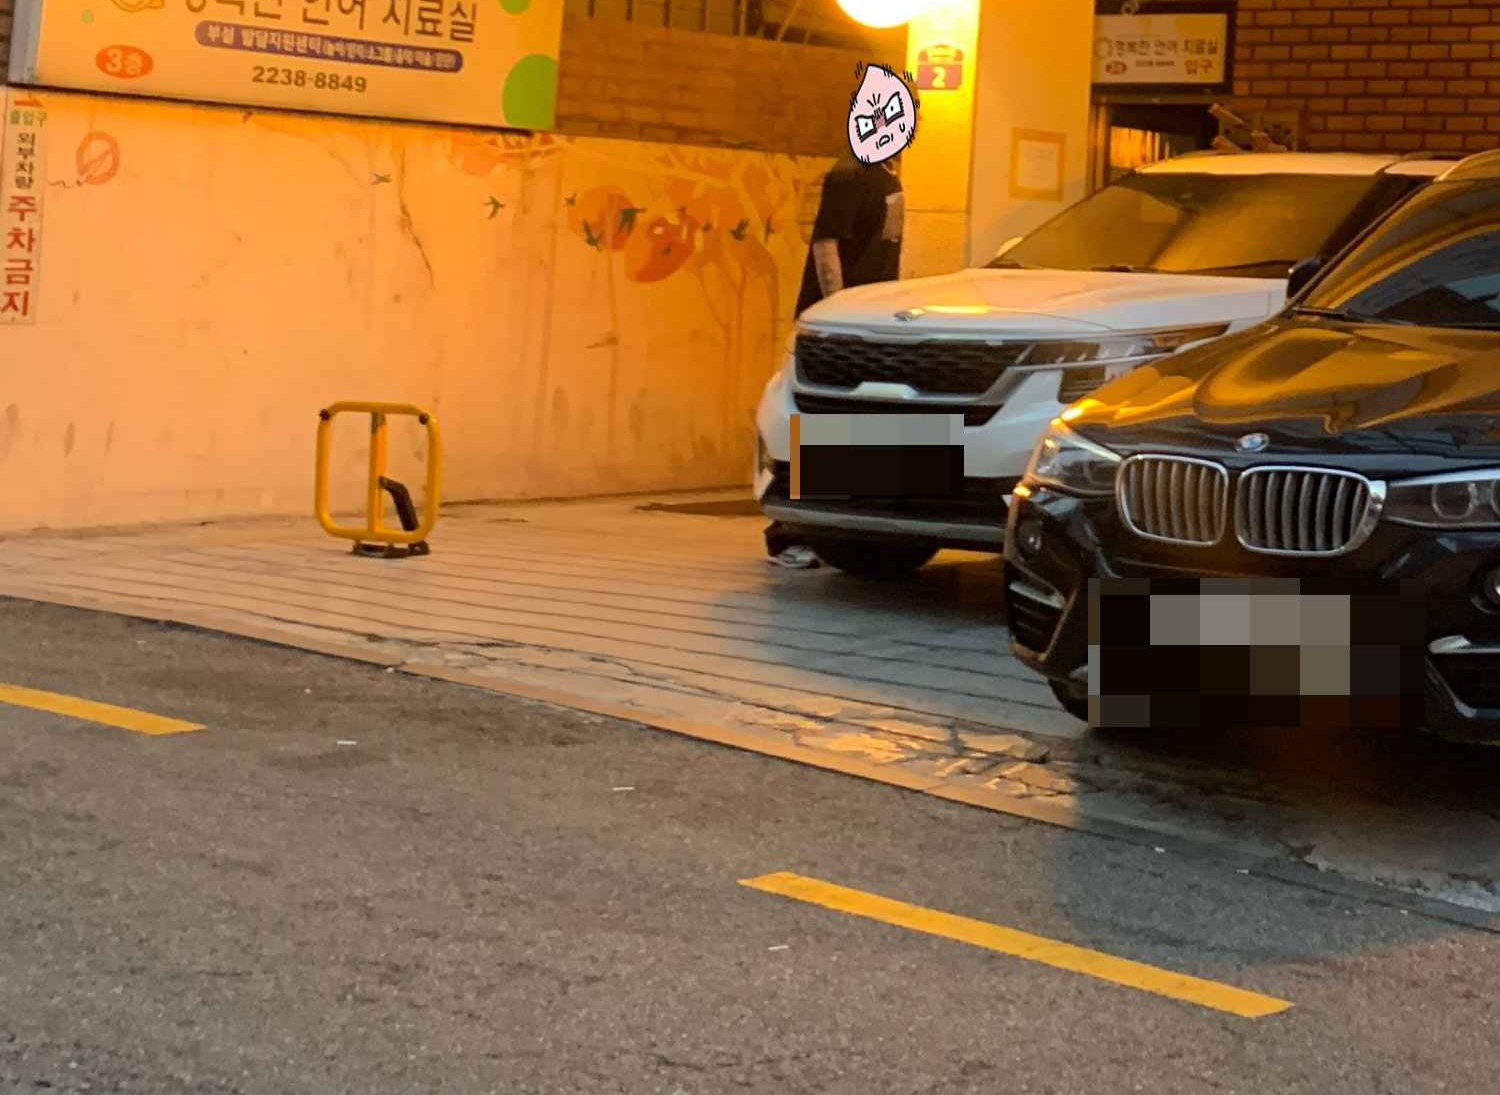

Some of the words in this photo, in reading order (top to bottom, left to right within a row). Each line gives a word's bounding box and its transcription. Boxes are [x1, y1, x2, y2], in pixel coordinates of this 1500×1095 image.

[105, 48, 144, 75] 3층
[252, 65, 367, 93] 2238-8849
[931, 66, 946, 88] 2
[10, 110, 48, 127] 출입구
[15, 131, 36, 190] 외부차량
[1, 194, 38, 316] 주차금지
